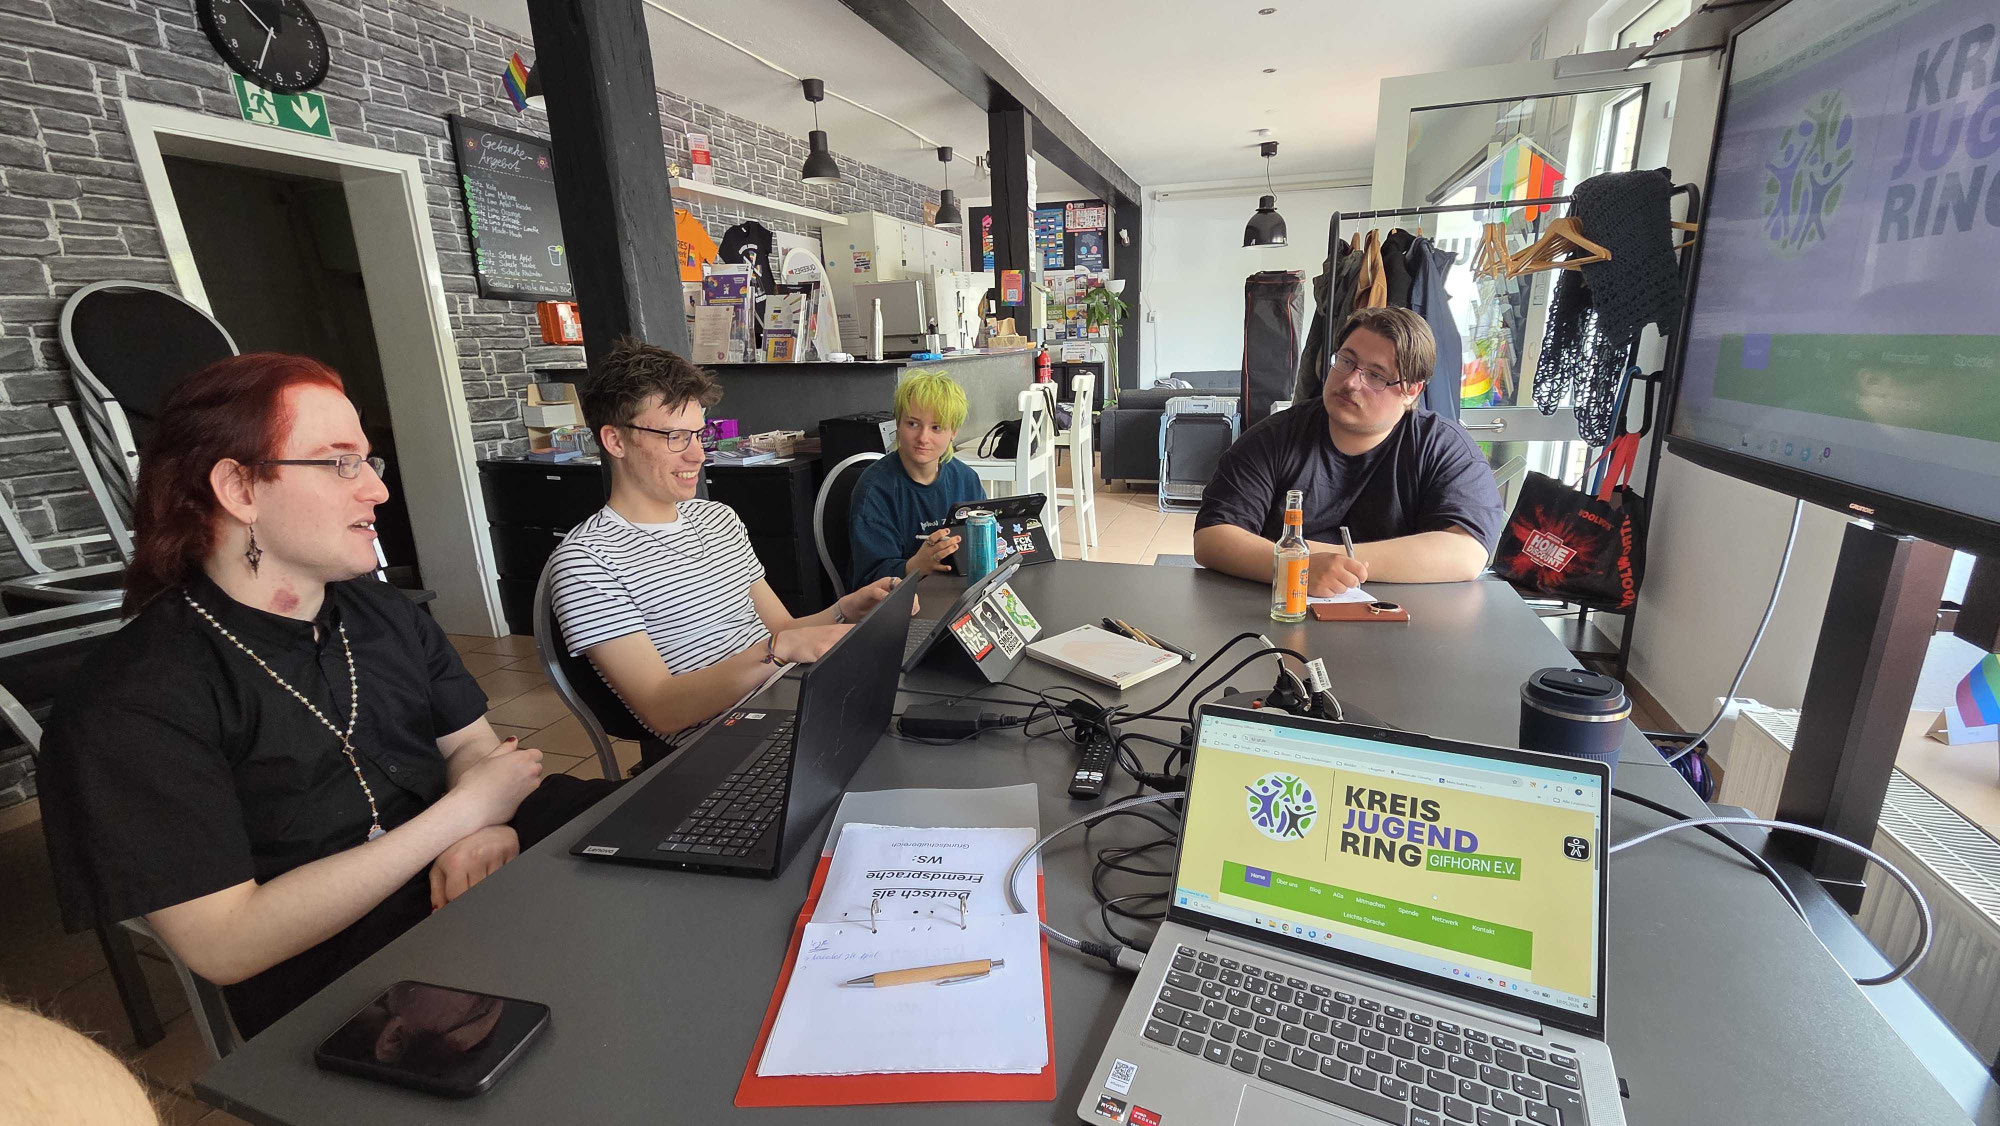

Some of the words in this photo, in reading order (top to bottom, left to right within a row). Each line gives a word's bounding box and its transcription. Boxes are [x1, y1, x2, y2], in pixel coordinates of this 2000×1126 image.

[219, 14, 226, 24] 9
[296, 17, 303, 26] 2
[231, 38, 239, 48] 8
[306, 40, 313, 49] 3
[1905, 23, 2000, 113] KR
[275, 72, 283, 81] 6
[295, 71, 303, 80] 5
[1013, 536, 1032, 545] FCK
[1016, 543, 1035, 552] NZS
[1531, 534, 1569, 562] HOME
[1527, 545, 1562, 568] DISCOUNT
[955, 619, 980, 643] FCK
[966, 632, 989, 656] NZS
[1345, 785, 1441, 822] KREIS
[1343, 809, 1479, 854] JUGEND
[1340, 831, 1422, 867] RING
[912, 855, 943, 864] WS:
[1429, 854, 1491, 872] GIFHORN
[1494, 862, 1516, 875] E.V.
[866, 871, 983, 884] Fremdsprache
[872, 890, 896, 900] als
[1250, 872, 1266, 881] Home
[1288, 880, 1298, 888] uns
[1309, 886, 1322, 895] Blog
[1333, 891, 1344, 900] AGs
[1355, 897, 1386, 910] Mitmachen
[1398, 907, 1419, 917] Spende
[1431, 915, 1459, 927] Netzwerk
[1472, 924, 1495, 936] Kontakt
[1343, 911, 1363, 922] Leichte
[1363, 916, 1386, 927] Sprache
[1401, 1061, 1407, 1069] K
[1354, 1068, 1361, 1076] N
[1384, 1078, 1392, 1086] M
[1101, 1102, 1122, 1114] RYZEN
